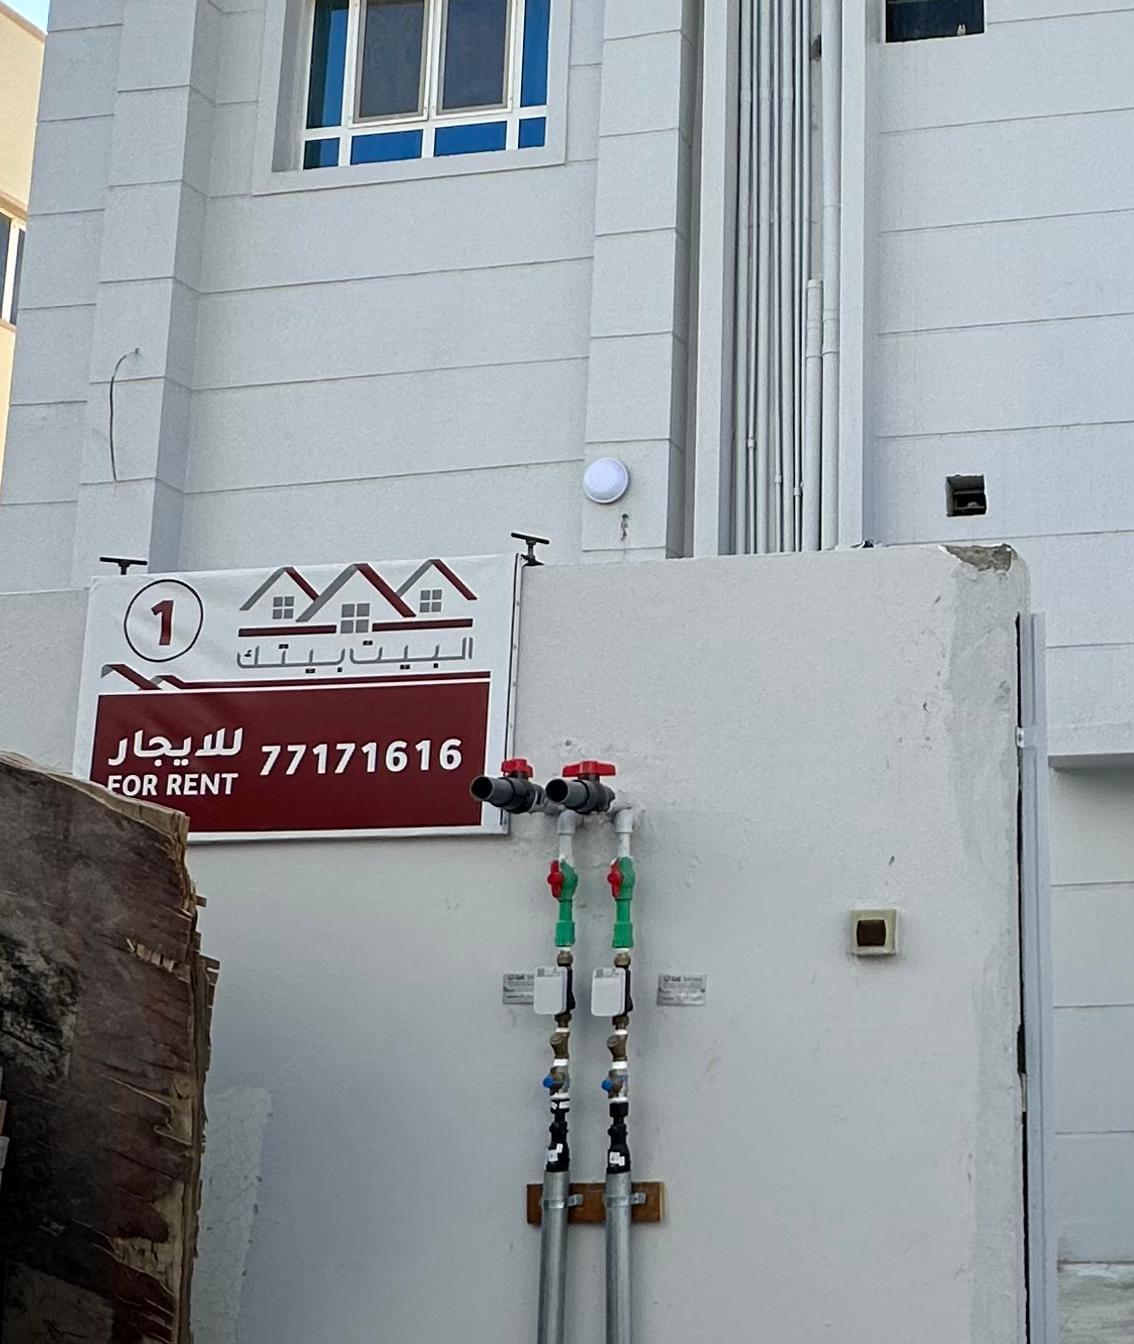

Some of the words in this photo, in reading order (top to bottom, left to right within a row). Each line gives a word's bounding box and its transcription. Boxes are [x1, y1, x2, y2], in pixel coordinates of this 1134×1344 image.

[151, 599, 174, 646] 1
[236, 644, 347, 674] بيتك
[349, 637, 474, 670] البيت
[259, 738, 463, 776] 77171616
[107, 773, 159, 797] FOR
[166, 772, 239, 796] RENT
